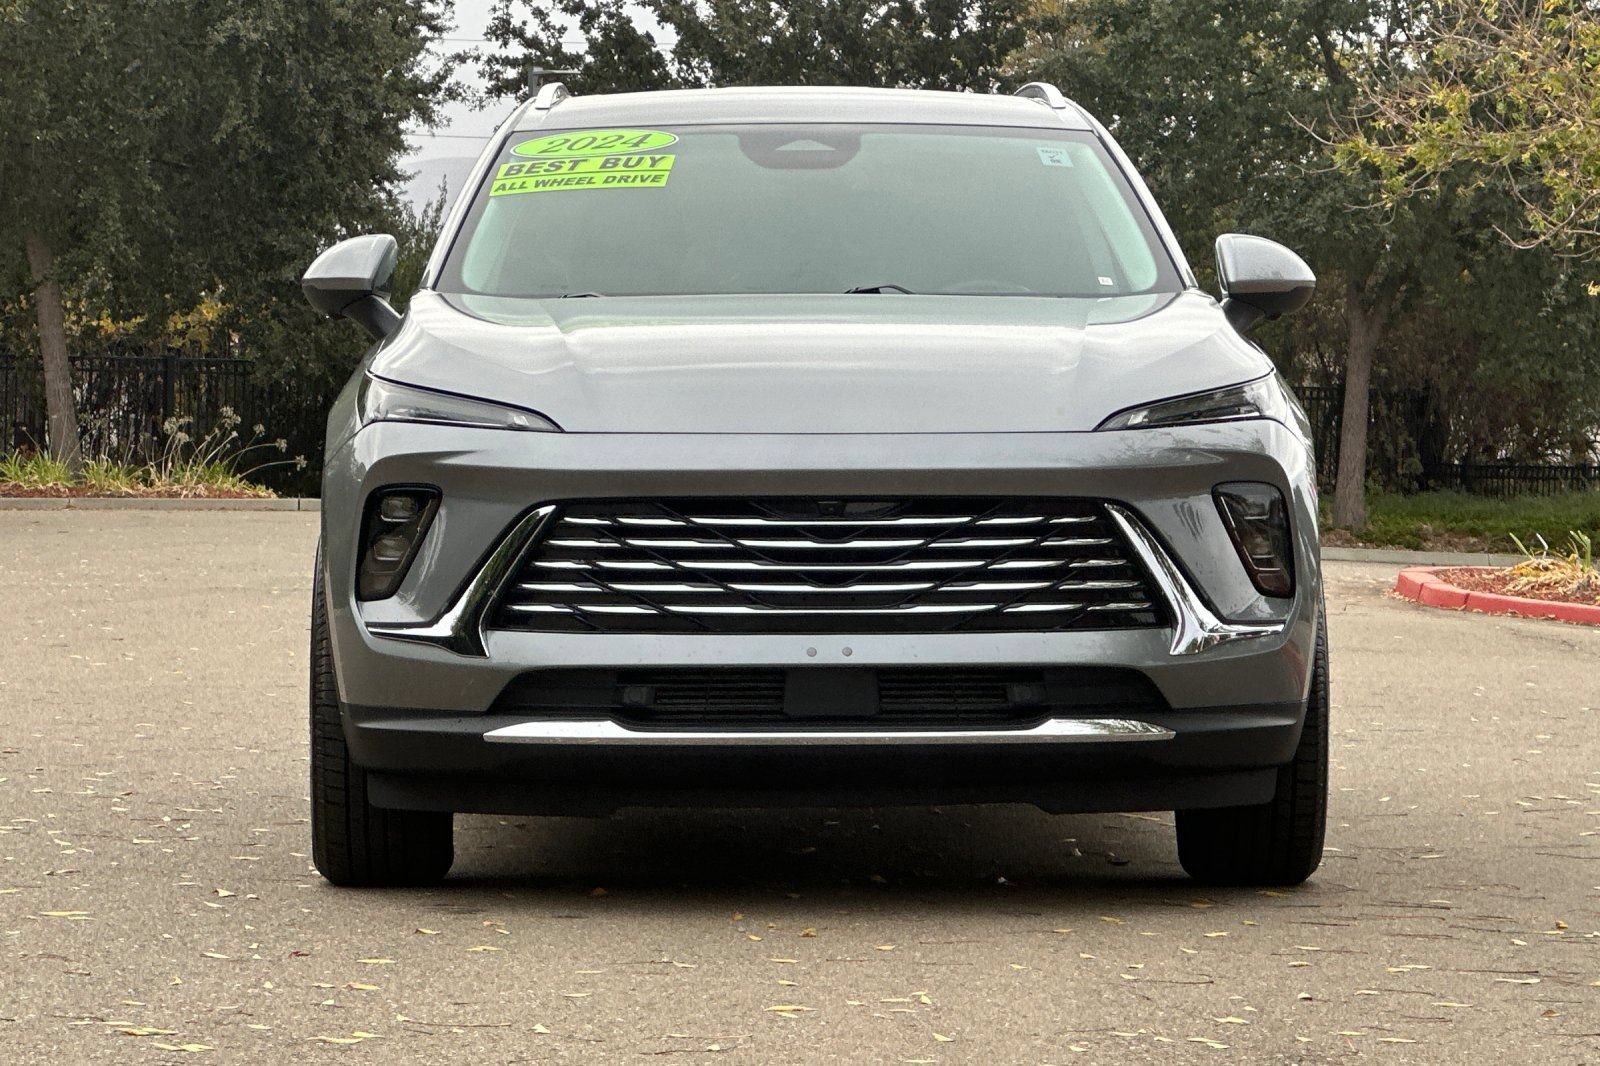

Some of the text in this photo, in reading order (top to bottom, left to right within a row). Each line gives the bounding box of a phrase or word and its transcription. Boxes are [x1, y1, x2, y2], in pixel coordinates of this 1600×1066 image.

[536, 133, 653, 154] 2024
[503, 155, 667, 177] BEST BUY
[493, 174, 665, 193] ALL WHEEL DRIVE
